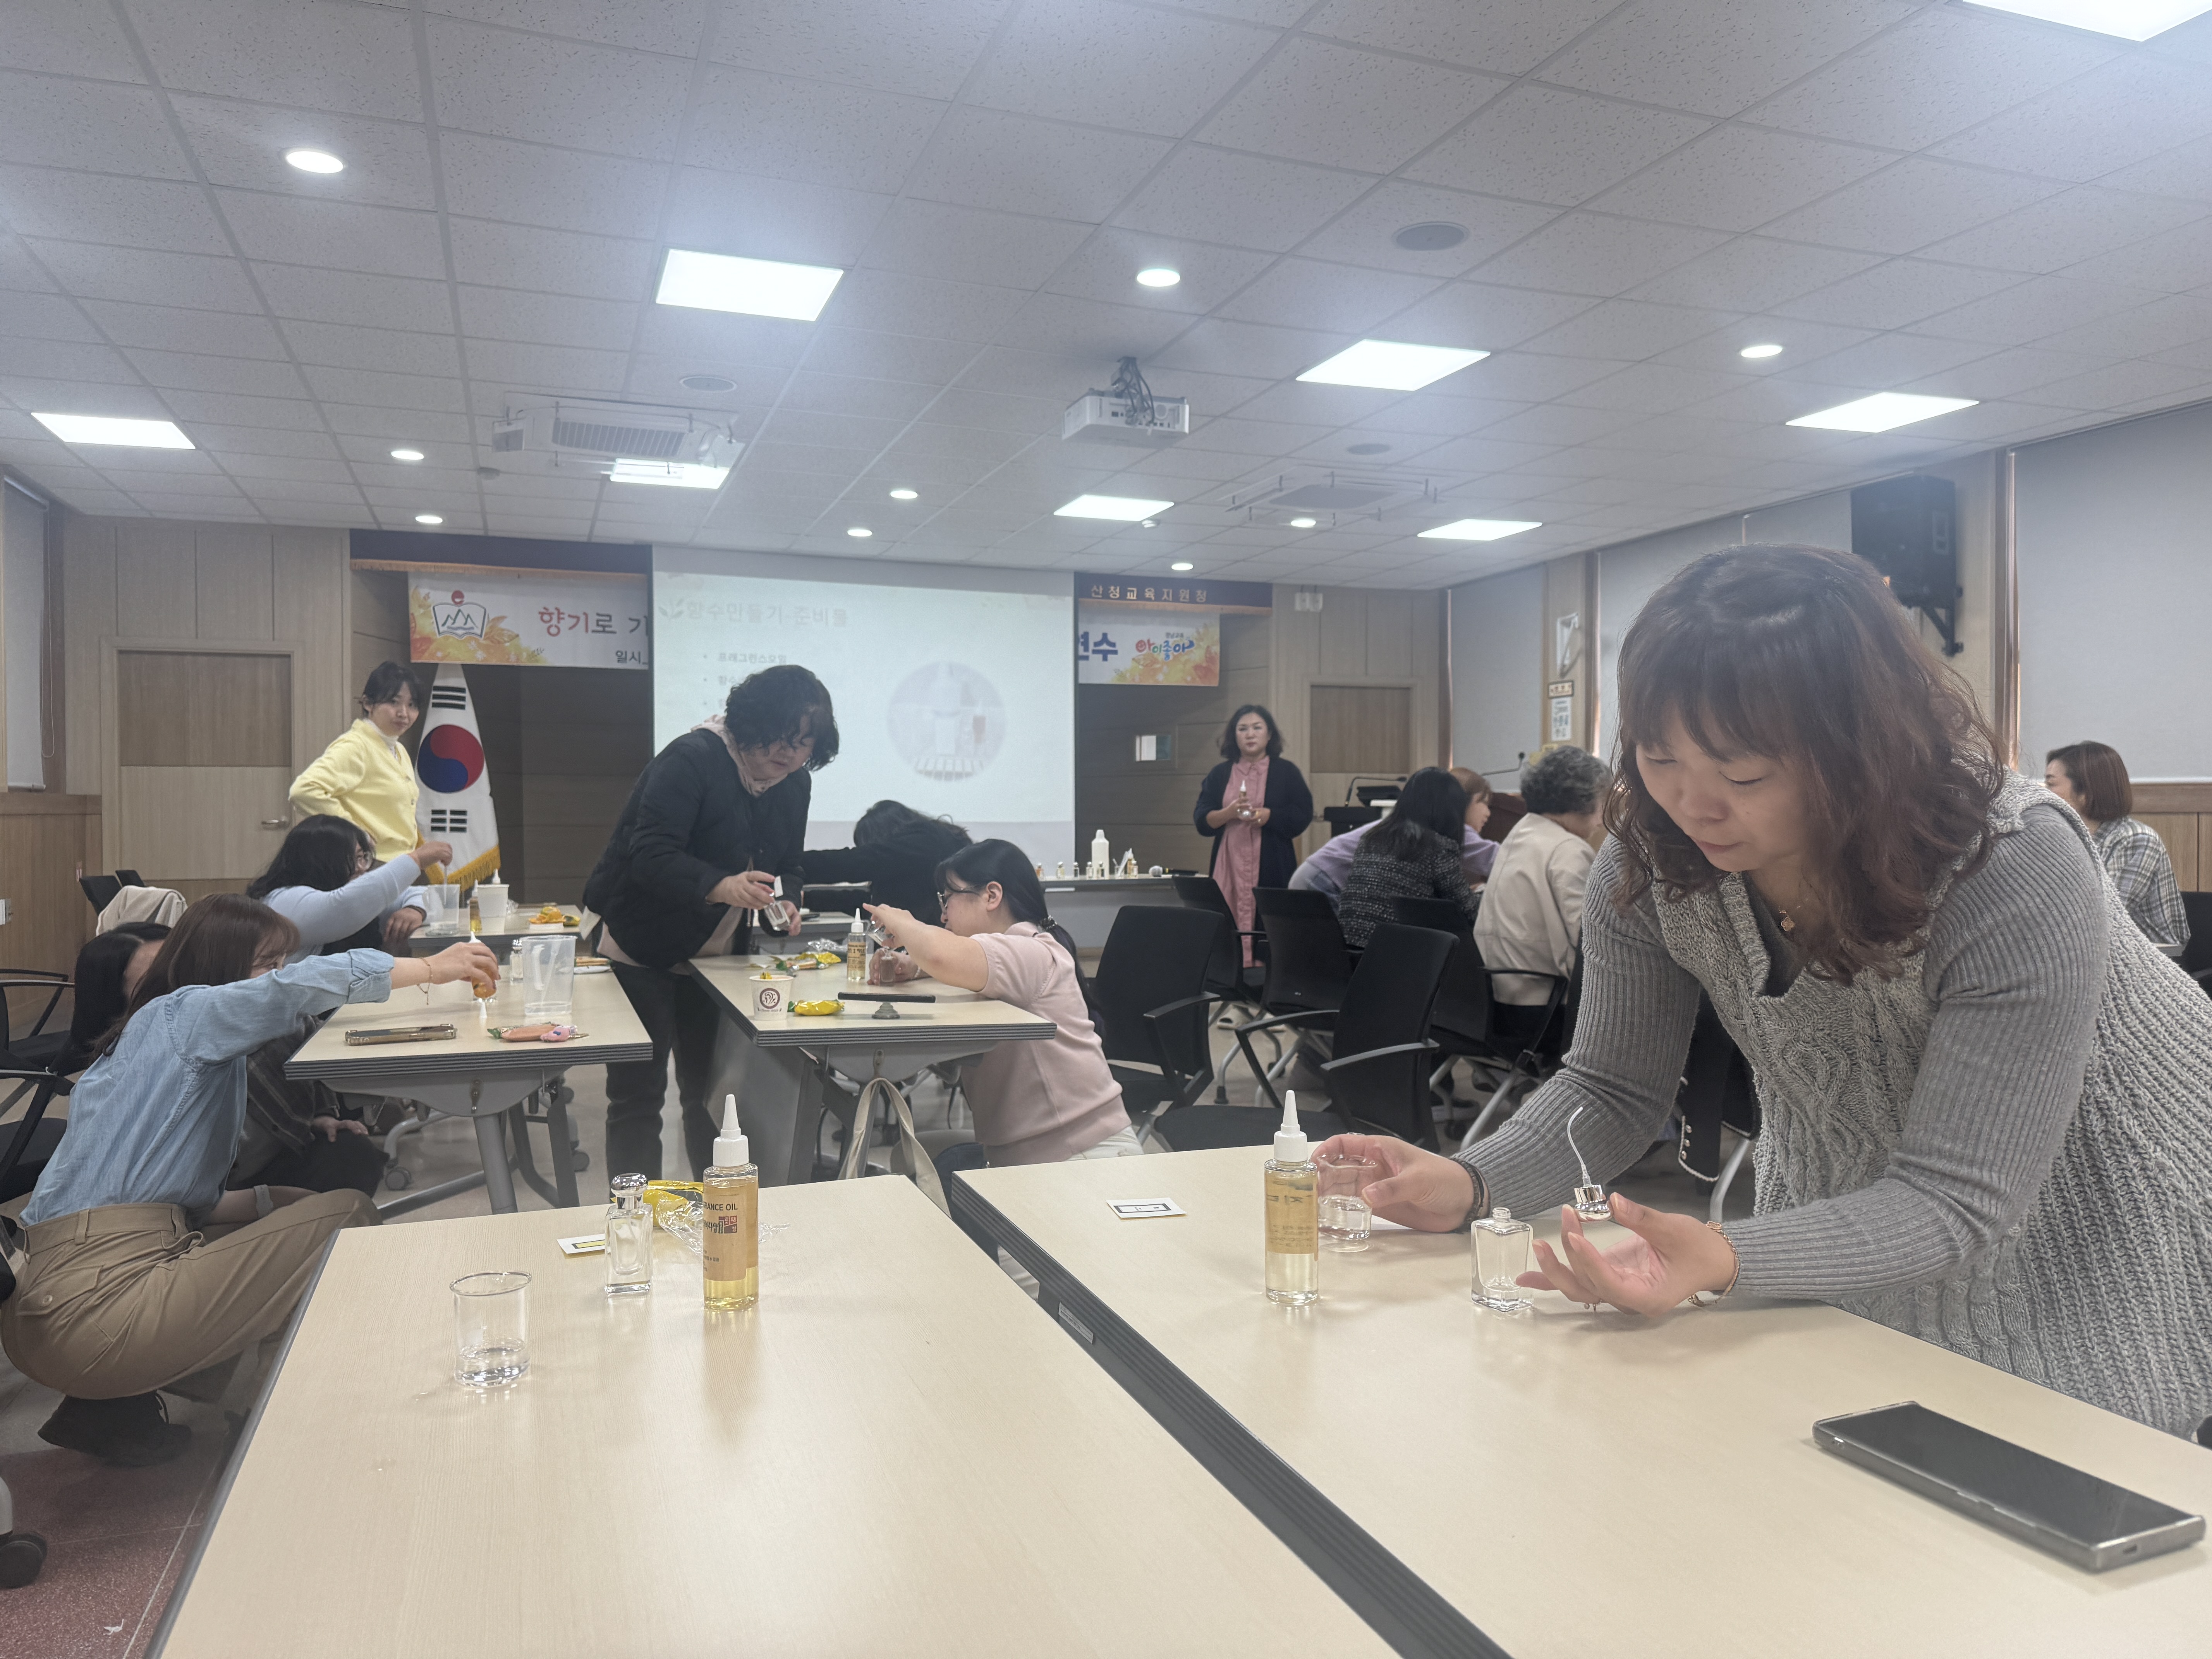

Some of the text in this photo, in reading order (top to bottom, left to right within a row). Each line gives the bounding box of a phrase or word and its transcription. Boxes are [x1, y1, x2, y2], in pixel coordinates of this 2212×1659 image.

[1091, 584, 1207, 603] 산청교육지원청
[538, 606, 617, 637] 향기로
[1135, 639, 1195, 661] 아이좋아
[703, 1201, 723, 1211] RANCE
